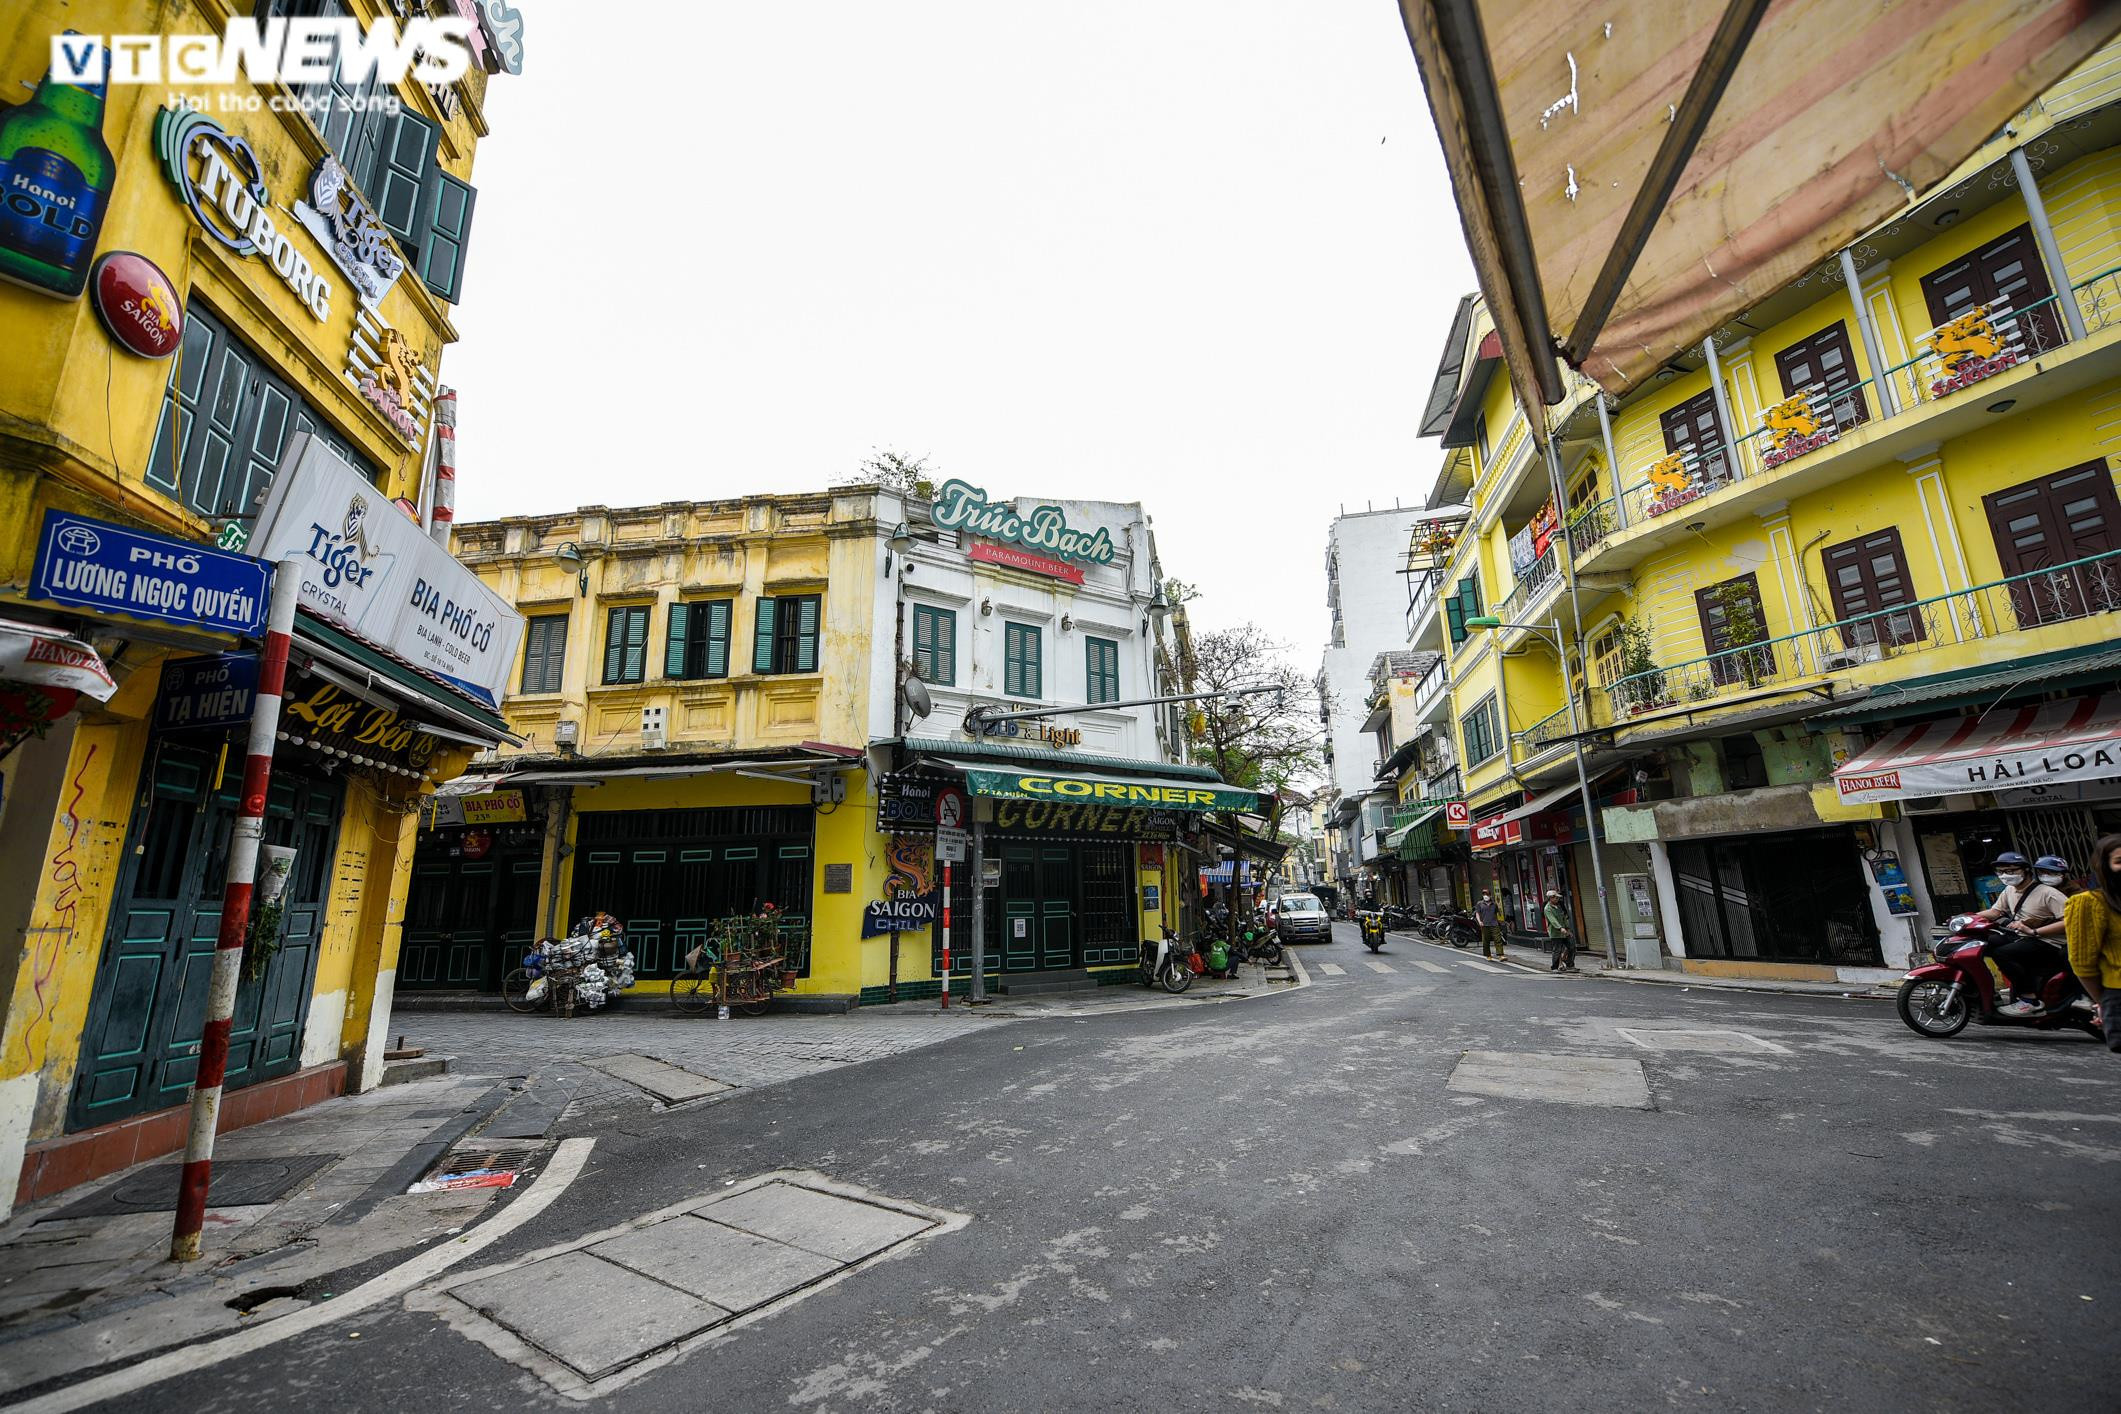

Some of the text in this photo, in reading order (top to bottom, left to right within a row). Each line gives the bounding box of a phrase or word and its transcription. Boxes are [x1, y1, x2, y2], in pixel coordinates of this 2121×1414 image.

[13, 174, 76, 210] Hanoi
[0, 184, 94, 240] OLD
[201, 139, 332, 324] TUBORG
[343, 191, 404, 280] Tiger
[121, 300, 166, 347] SAIGON
[146, 309, 161, 325] BIA
[1931, 352, 2018, 397] SAIGON
[361, 377, 417, 441] SAIGON
[1764, 432, 1830, 468] SAIGON
[1648, 489, 1698, 518] SAIGON
[936, 483, 1111, 561] Trúc Bạch
[129, 547, 202, 575] PHỐ
[305, 522, 373, 592] Tiger
[985, 548, 1069, 575] PARAMOUNT BEER
[52, 557, 254, 623] LƯƠNG NGỌC QUYẾN
[302, 580, 348, 616] CRYSTAL
[410, 577, 495, 653] BIA PHỐ CỔ
[32, 640, 84, 667] HANOI
[416, 625, 428, 639] BIA
[444, 642, 459, 658] COLD
[457, 650, 471, 664] BEER
[194, 662, 231, 685] PHỐ
[168, 685, 249, 725] TẠ HIỆN
[287, 683, 362, 734] Lợi
[1024, 727, 1033, 739] &
[1041, 721, 1081, 749] Light
[1967, 747, 2121, 782] HẢI LOA
[901, 784, 931, 798] Hanoi
[1018, 777, 1216, 805] CORNER
[1841, 773, 1899, 792] HANOI BEER
[2022, 794, 2066, 804] CRYSTAL
[465, 792, 521, 811] BIA PHỐ CỔ
[998, 799, 1150, 832] CORNER
[1148, 816, 1176, 825] SAIGON
[871, 900, 936, 918] SAIGON
[897, 889, 917, 899] BIA
[875, 918, 926, 932] CHILL
